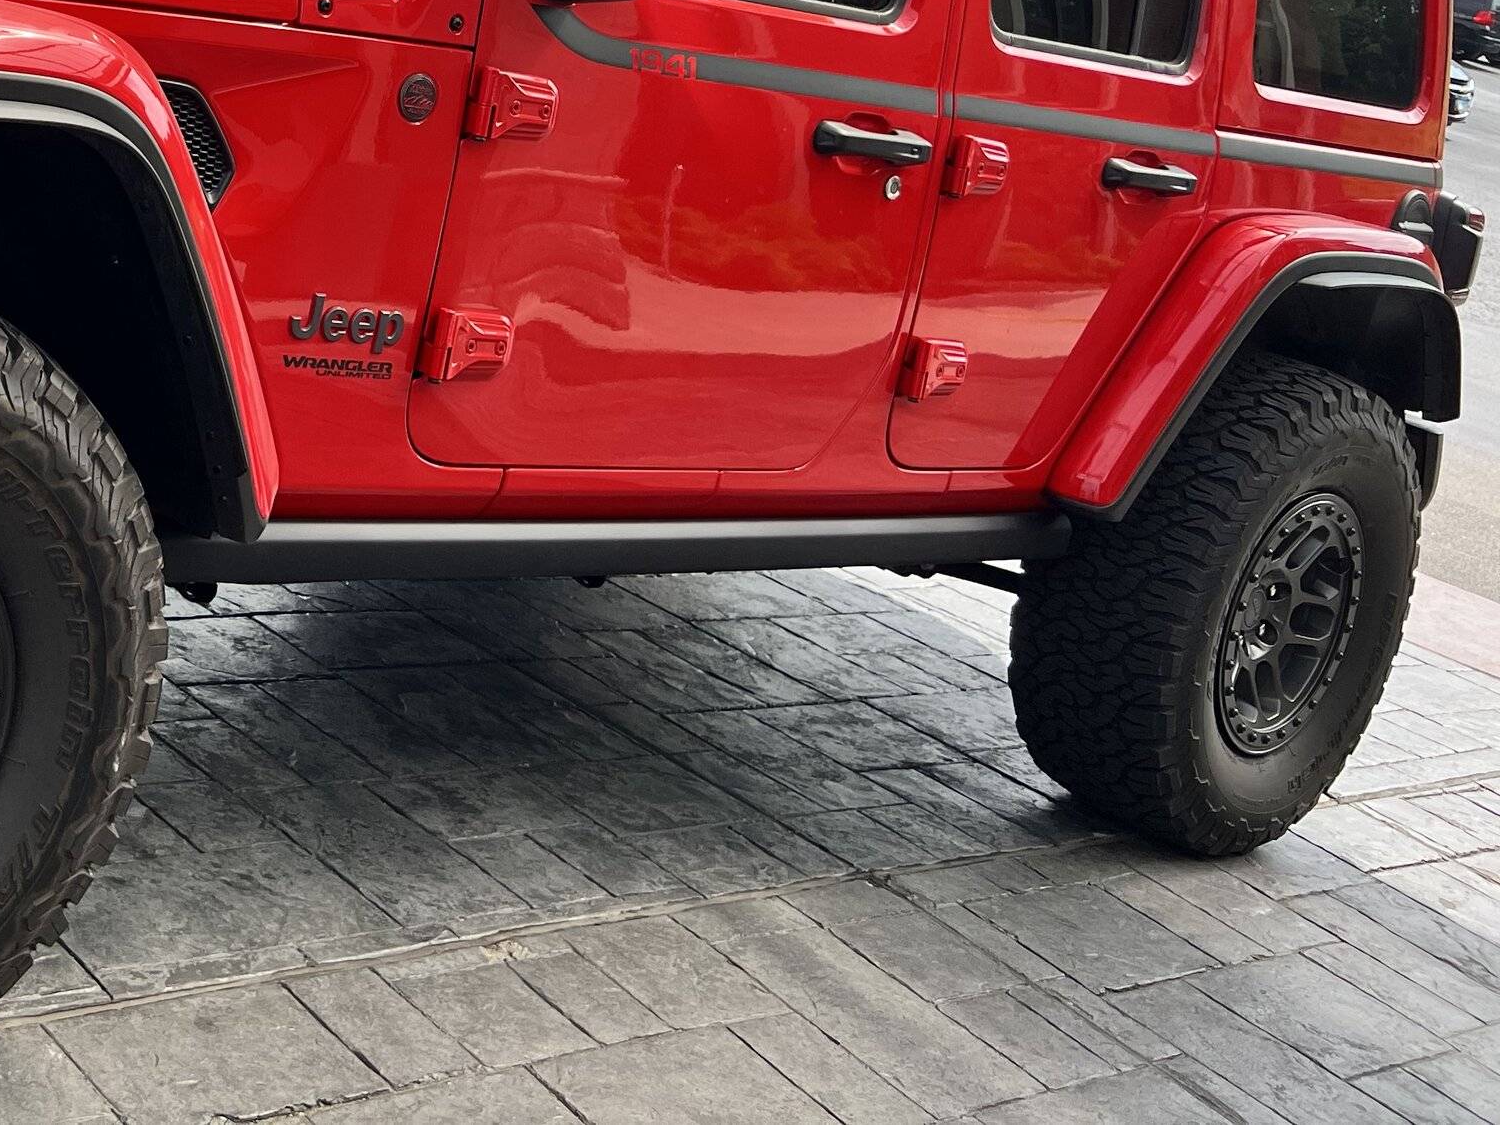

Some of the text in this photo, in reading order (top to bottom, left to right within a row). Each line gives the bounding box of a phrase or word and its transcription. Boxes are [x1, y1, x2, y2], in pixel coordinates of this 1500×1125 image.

[629, 45, 698, 81] 1941
[289, 292, 405, 355] Jeep
[282, 354, 393, 374] WRANGLER
[315, 369, 392, 380] UNLIMITED
